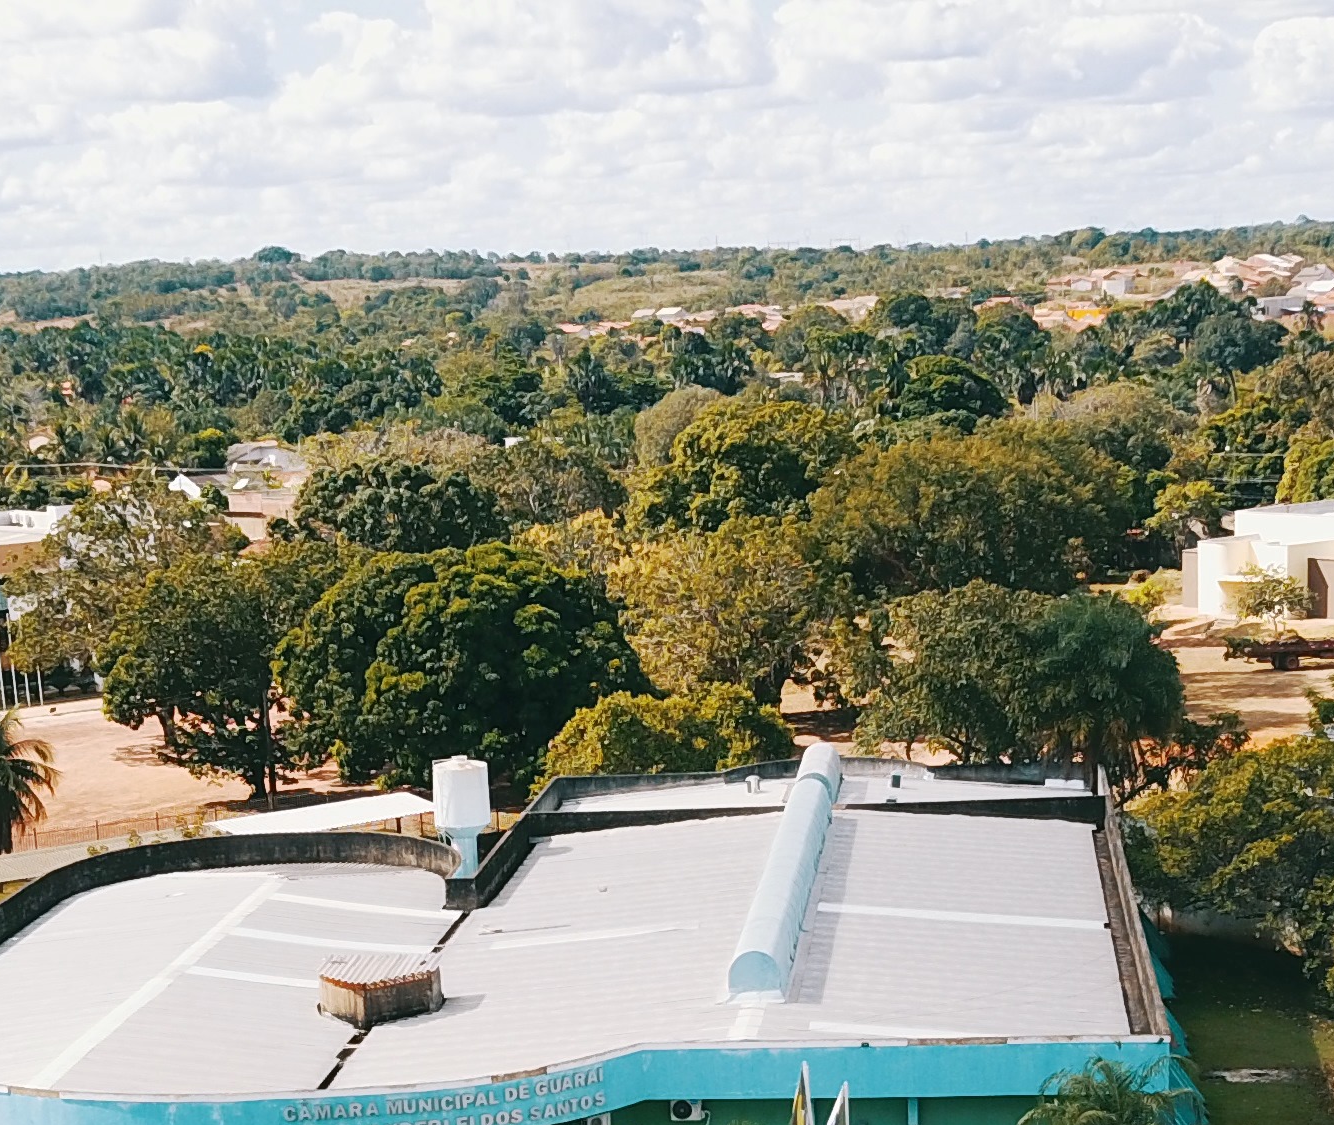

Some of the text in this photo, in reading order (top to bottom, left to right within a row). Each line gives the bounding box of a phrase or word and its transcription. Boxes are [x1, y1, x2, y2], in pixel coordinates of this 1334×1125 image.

[387, 1091, 498, 1115] MUNICIPAL
[504, 1084, 530, 1102] DE
[530, 1091, 606, 1120] SANTOS
